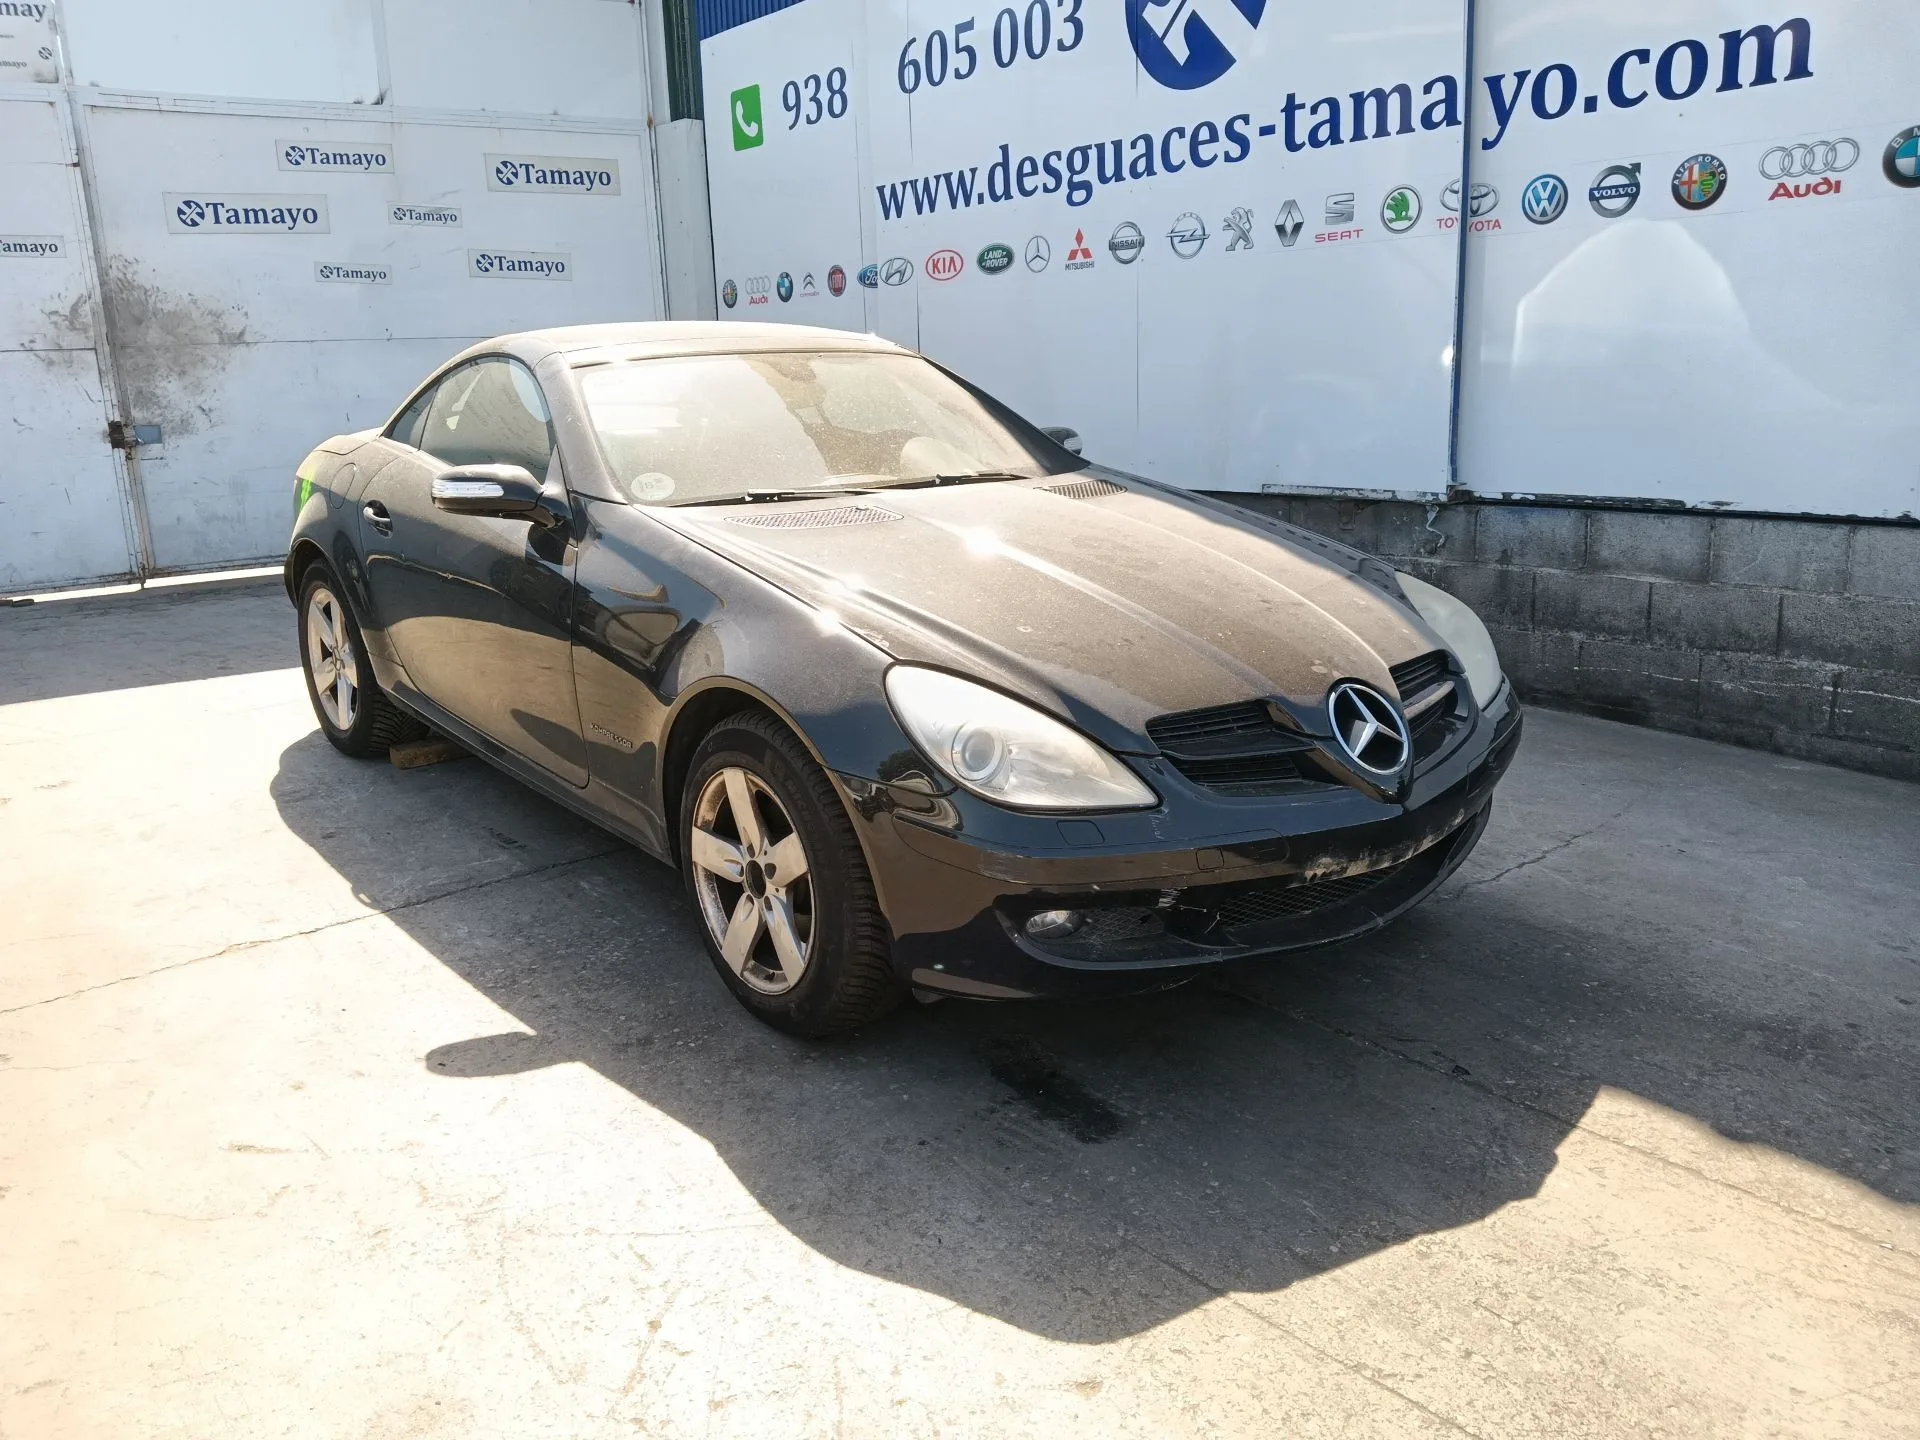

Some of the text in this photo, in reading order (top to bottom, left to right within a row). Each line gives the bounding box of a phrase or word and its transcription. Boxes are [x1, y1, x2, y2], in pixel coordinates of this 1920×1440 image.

[782, 0, 1084, 131] 938 605 003
[876, 17, 1815, 221] www.desguaces-tamayo.com
[305, 147, 387, 170] Tamayo
[519, 163, 612, 191] Tamayo
[1592, 186, 1637, 198] VOLVO
[1767, 176, 1842, 201] Audi
[205, 202, 318, 230] Tamayo
[406, 208, 458, 225] Tamayo
[1111, 237, 1142, 248] NISSAN
[1314, 228, 1364, 243] SEAT
[0, 239, 58, 257] amayo
[984, 249, 1004, 260] LAND
[494, 255, 565, 277] Tamayo
[932, 255, 958, 275] KIA
[985, 257, 1009, 268] ROVER
[1064, 260, 1095, 271] MITSUBISHI
[333, 266, 387, 282] Tamayo
